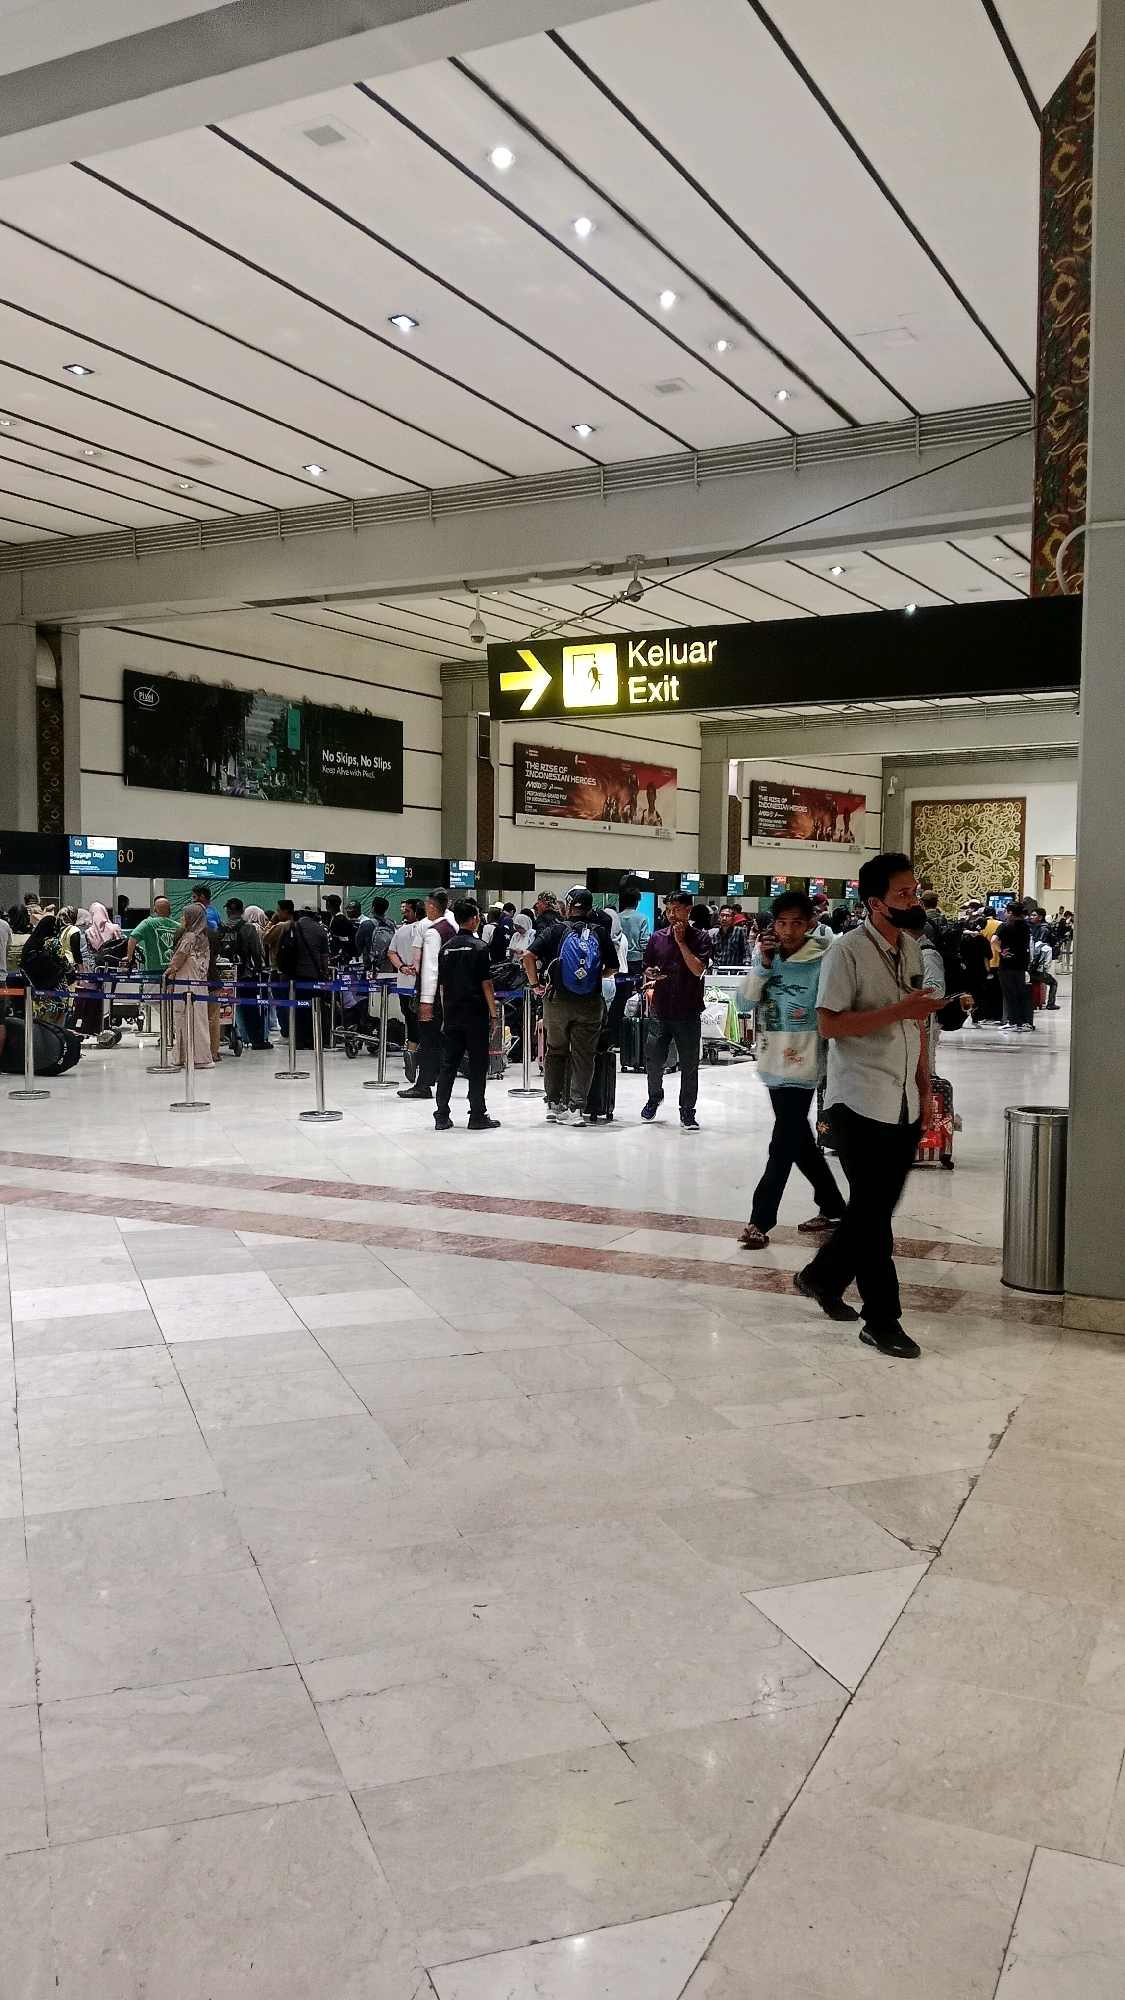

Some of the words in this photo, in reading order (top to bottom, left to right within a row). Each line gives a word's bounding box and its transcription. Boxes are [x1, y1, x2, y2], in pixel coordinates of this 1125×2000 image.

[628, 637, 718, 668] Keluar
[628, 674, 680, 704] Exit
[138, 691, 154, 703] Pixel
[322, 749, 335, 762] No
[336, 751, 359, 768] Skips,
[360, 754, 372, 767] No
[373, 756, 392, 772] Slips
[525, 760, 540, 771] THE
[540, 763, 559, 774] RISE
[558, 766, 569, 774] OF
[321, 764, 336, 776] Keep
[336, 766, 350, 776] Alive
[350, 768, 362, 777] with
[525, 769, 570, 783] INDONESIAN
[570, 775, 597, 786] HEROES
[758, 794, 769, 802] THE
[92, 851, 105, 859] Drop
[118, 849, 134, 863] 60
[230, 857, 241, 870] 61
[325, 863, 335, 875] 62
